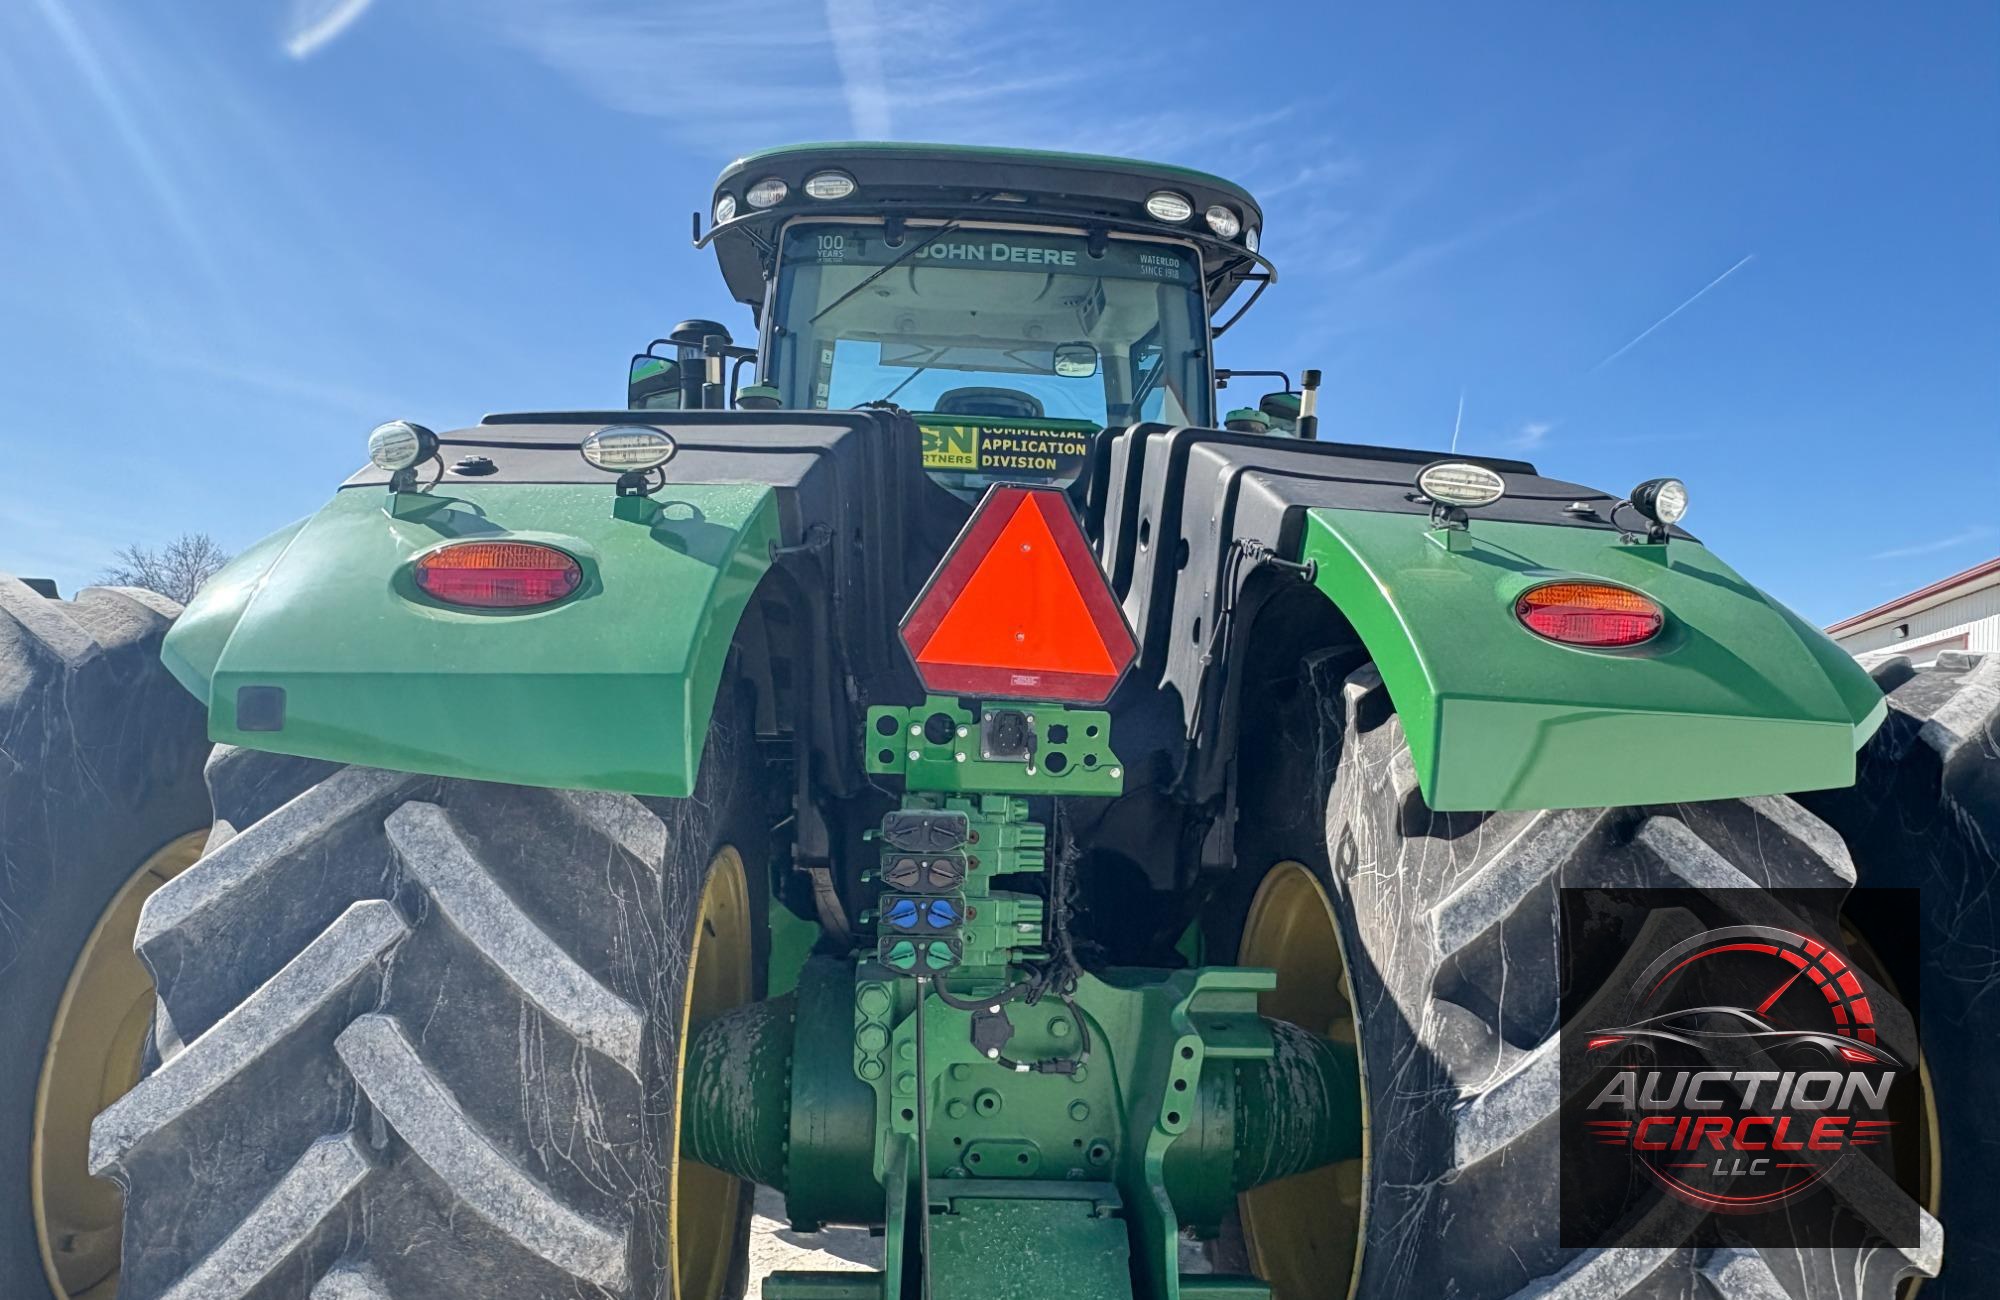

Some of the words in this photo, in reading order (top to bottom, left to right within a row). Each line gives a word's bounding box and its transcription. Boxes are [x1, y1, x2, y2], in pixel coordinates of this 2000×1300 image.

[817, 235, 844, 250] 100
[817, 250, 844, 258] YEARS
[914, 243, 985, 261] JOHN
[991, 243, 1077, 266] DEERE
[1140, 254, 1180, 268] WATERLOO
[1141, 265, 1163, 277] SINCE
[982, 438, 1086, 456] APPLICATION
[923, 454, 973, 464] RTNERS
[981, 454, 1057, 470] DIVISION
